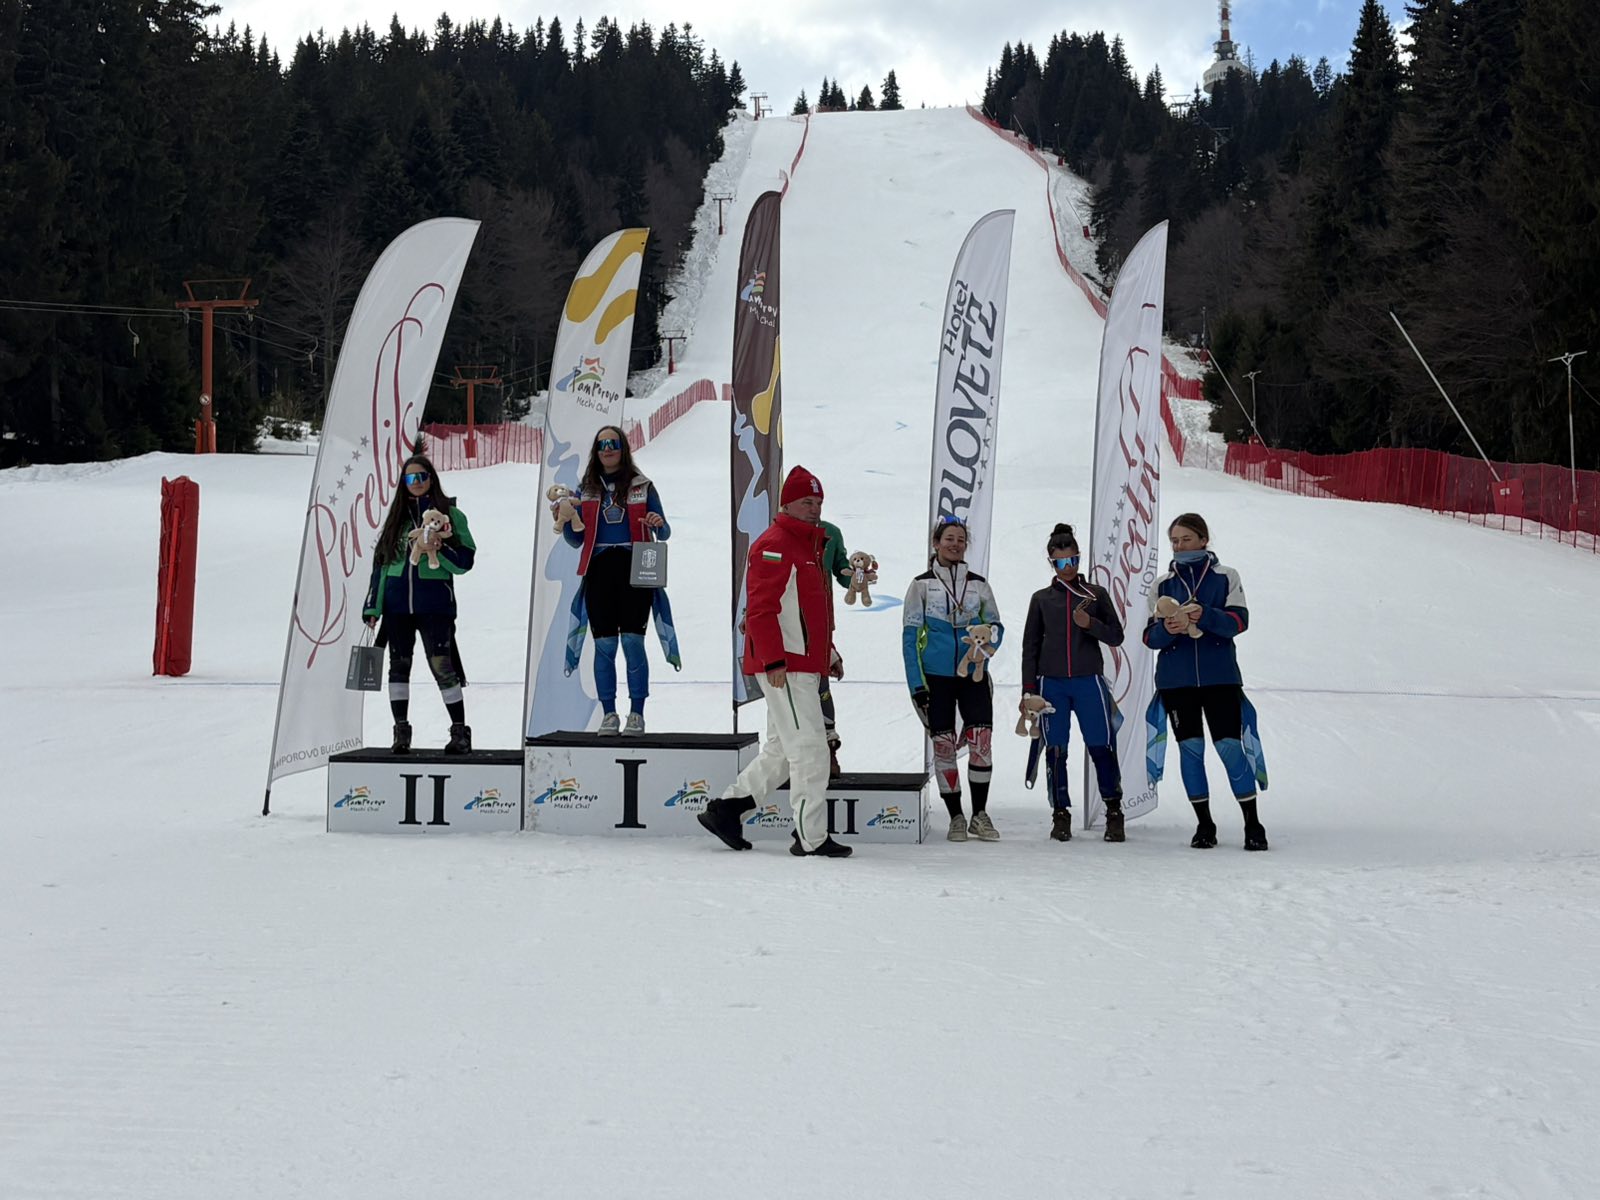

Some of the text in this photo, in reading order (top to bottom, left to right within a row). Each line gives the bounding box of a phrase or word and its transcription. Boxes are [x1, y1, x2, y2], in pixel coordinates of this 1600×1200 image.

[943, 280, 968, 355] Hotel
[937, 292, 997, 524] RLOVETZ
[320, 737, 361, 755] BULGARIA
[398, 774, 451, 825] II
[615, 759, 647, 829] I
[1122, 789, 1158, 809] LGARIA
